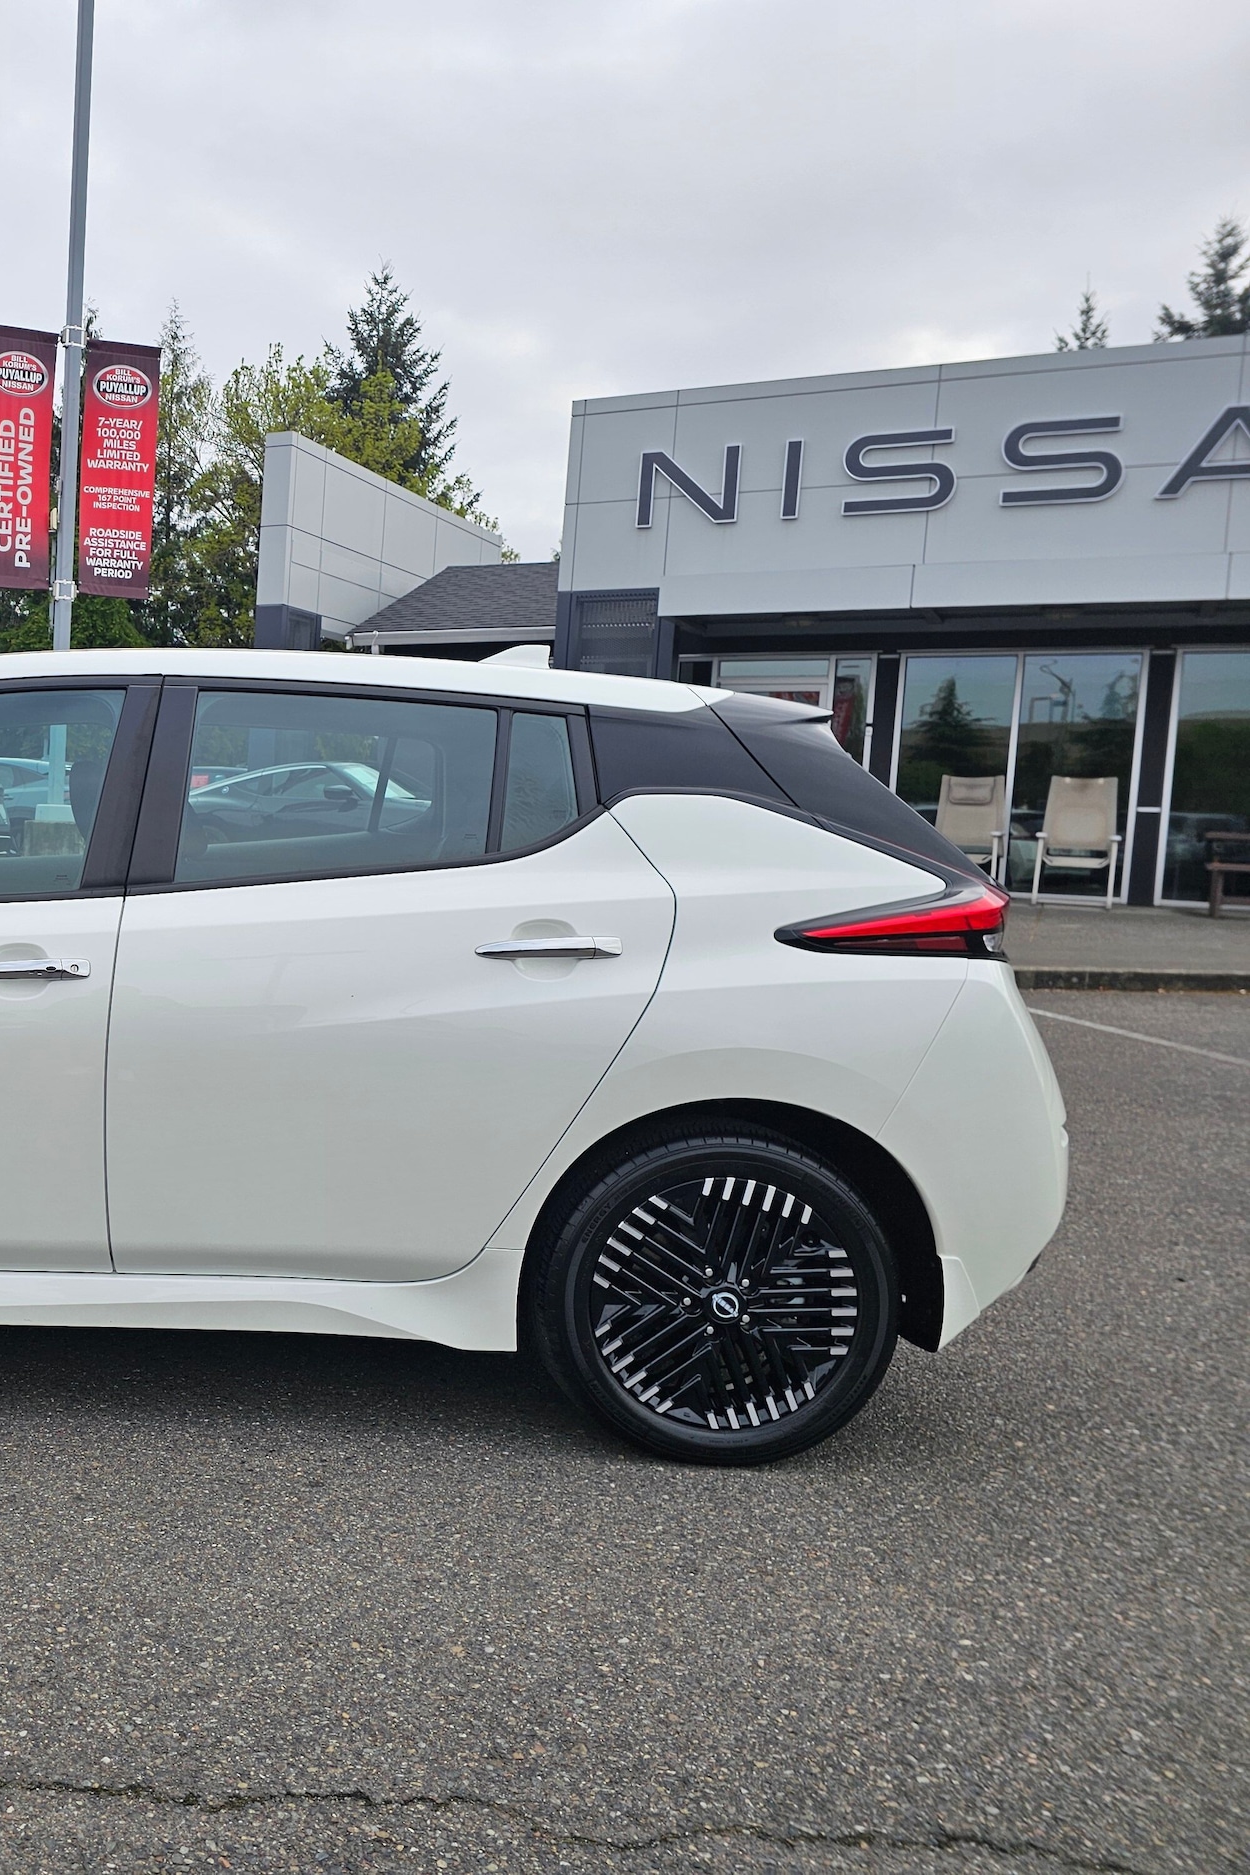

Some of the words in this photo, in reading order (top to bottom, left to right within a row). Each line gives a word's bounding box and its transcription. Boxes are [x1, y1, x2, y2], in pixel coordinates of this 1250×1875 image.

[2, 359, 37, 371] KORUM'S
[11, 354, 28, 364] BILL
[115, 368, 132, 376] BILL
[106, 373, 141, 384] KORUM'S
[1, 379, 34, 391] NISSAN
[100, 380, 146, 396] PUYALLUP
[105, 393, 138, 403] NISSAN
[98, 417, 143, 430] 7-YEAR/
[96, 427, 141, 440] 100,000
[103, 439, 137, 450] MILES
[97, 449, 141, 461] LIMITED
[87, 458, 149, 473] WARRANTY
[14, 407, 35, 568] PRE-OWNED
[83, 485, 150, 498] COMPREHENSIVE
[97, 494, 111, 502] 167
[112, 495, 137, 504] POINT
[93, 501, 140, 512] INSPECTION
[89, 527, 142, 540] ROADSIDE
[83, 538, 147, 551] ASSISTANCE
[89, 548, 112, 559] FOR
[113, 549, 138, 560] FULL
[85, 557, 143, 570] WARRANTY
[94, 567, 133, 579] PERIOD
